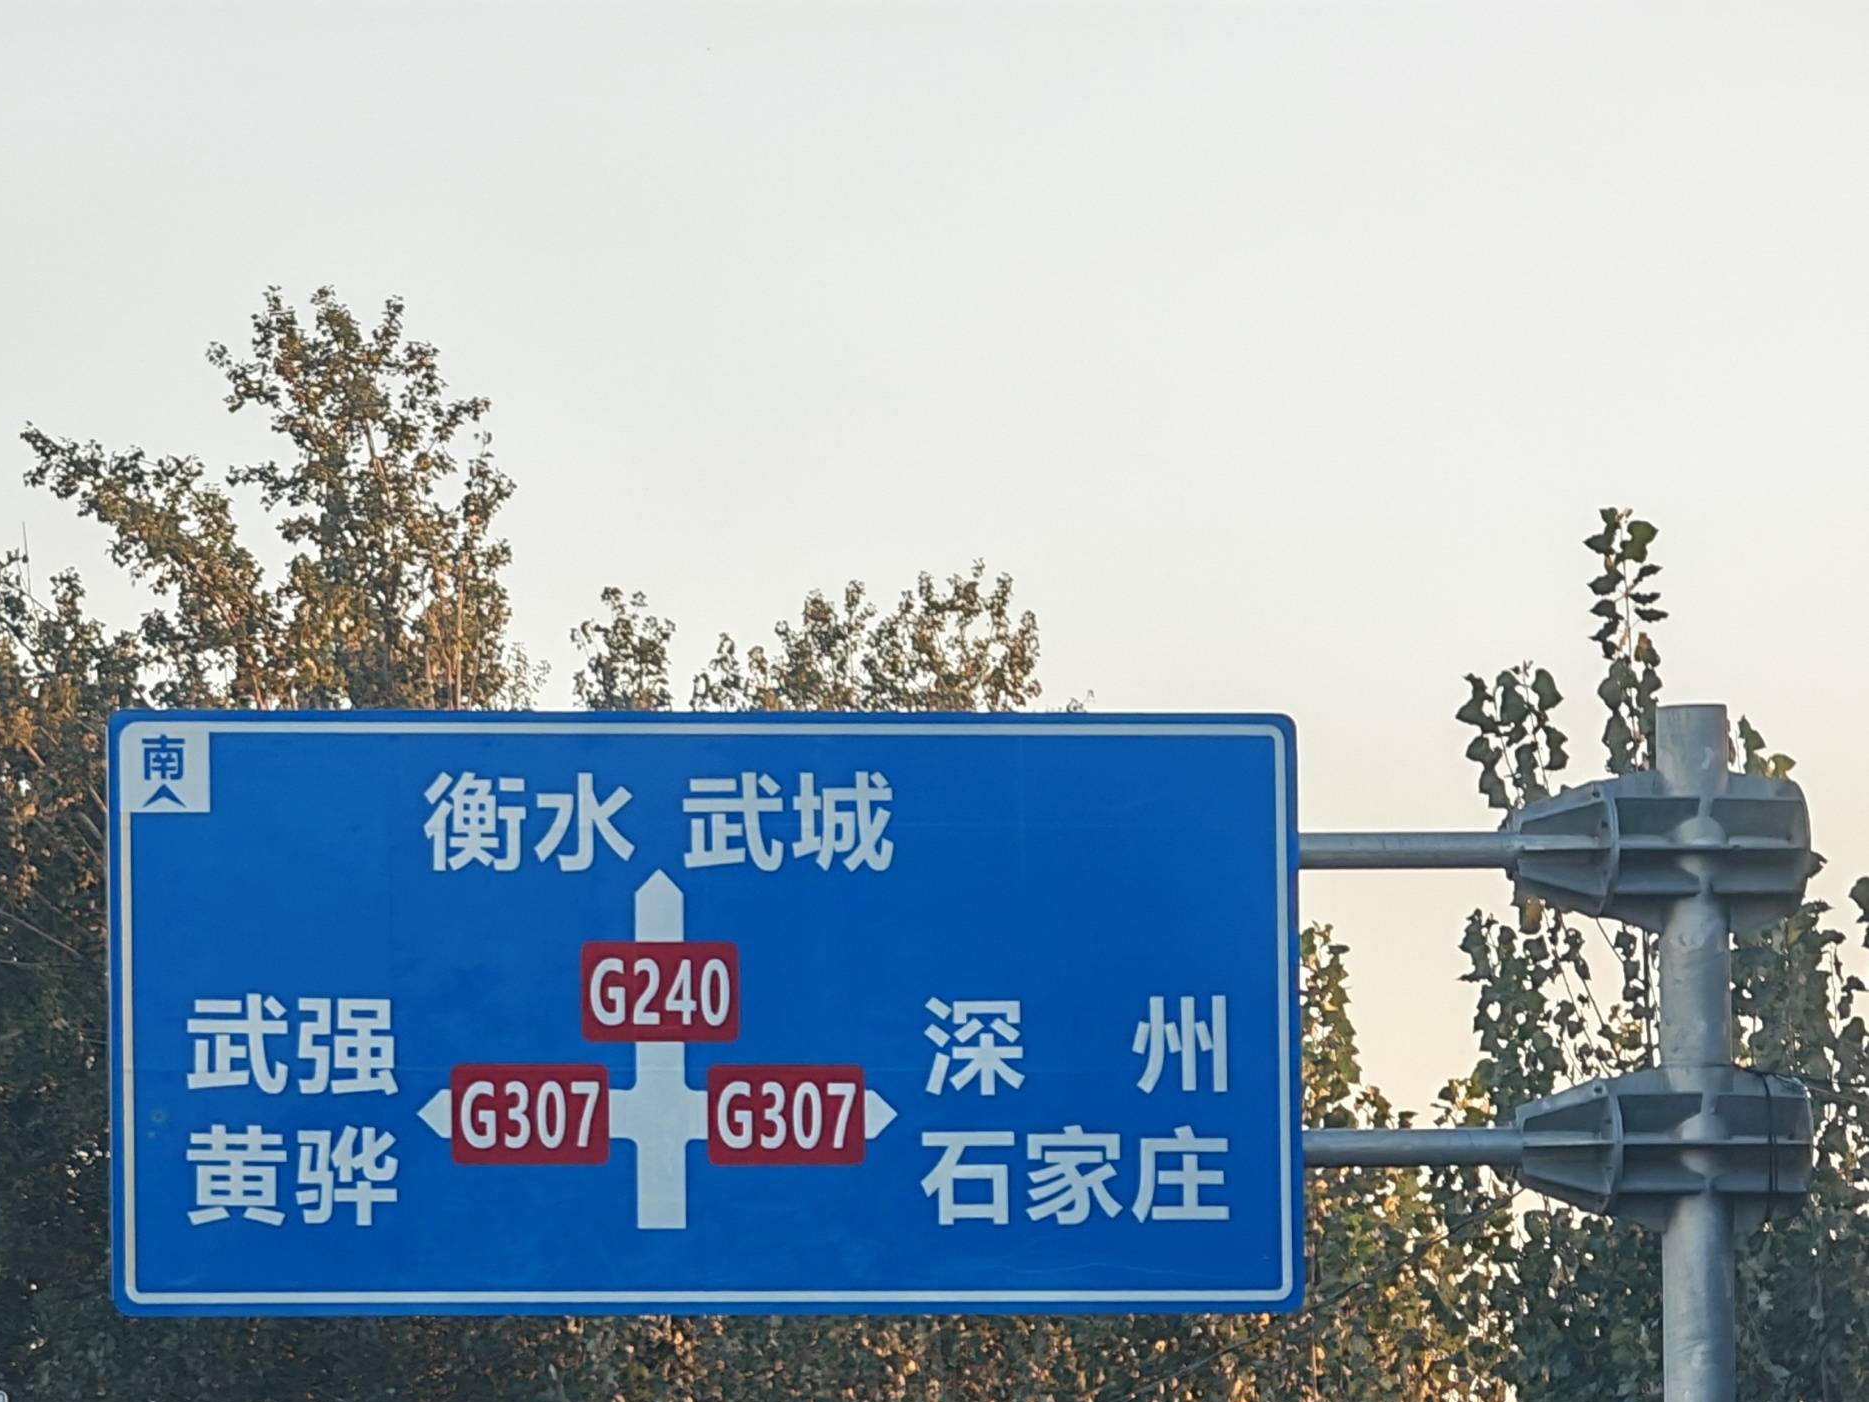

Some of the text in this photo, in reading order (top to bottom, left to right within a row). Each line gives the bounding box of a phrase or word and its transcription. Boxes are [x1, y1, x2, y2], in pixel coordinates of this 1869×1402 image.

[141, 734, 186, 780] 南
[424, 771, 894, 872] 衡水 武城
[589, 957, 730, 1027] G240
[186, 993, 399, 1096] 武强
[459, 1081, 601, 1151] G307
[716, 1081, 857, 1151] G307
[186, 1125, 399, 1227] 黄骅
[920, 1125, 1230, 1226] 石家庄
